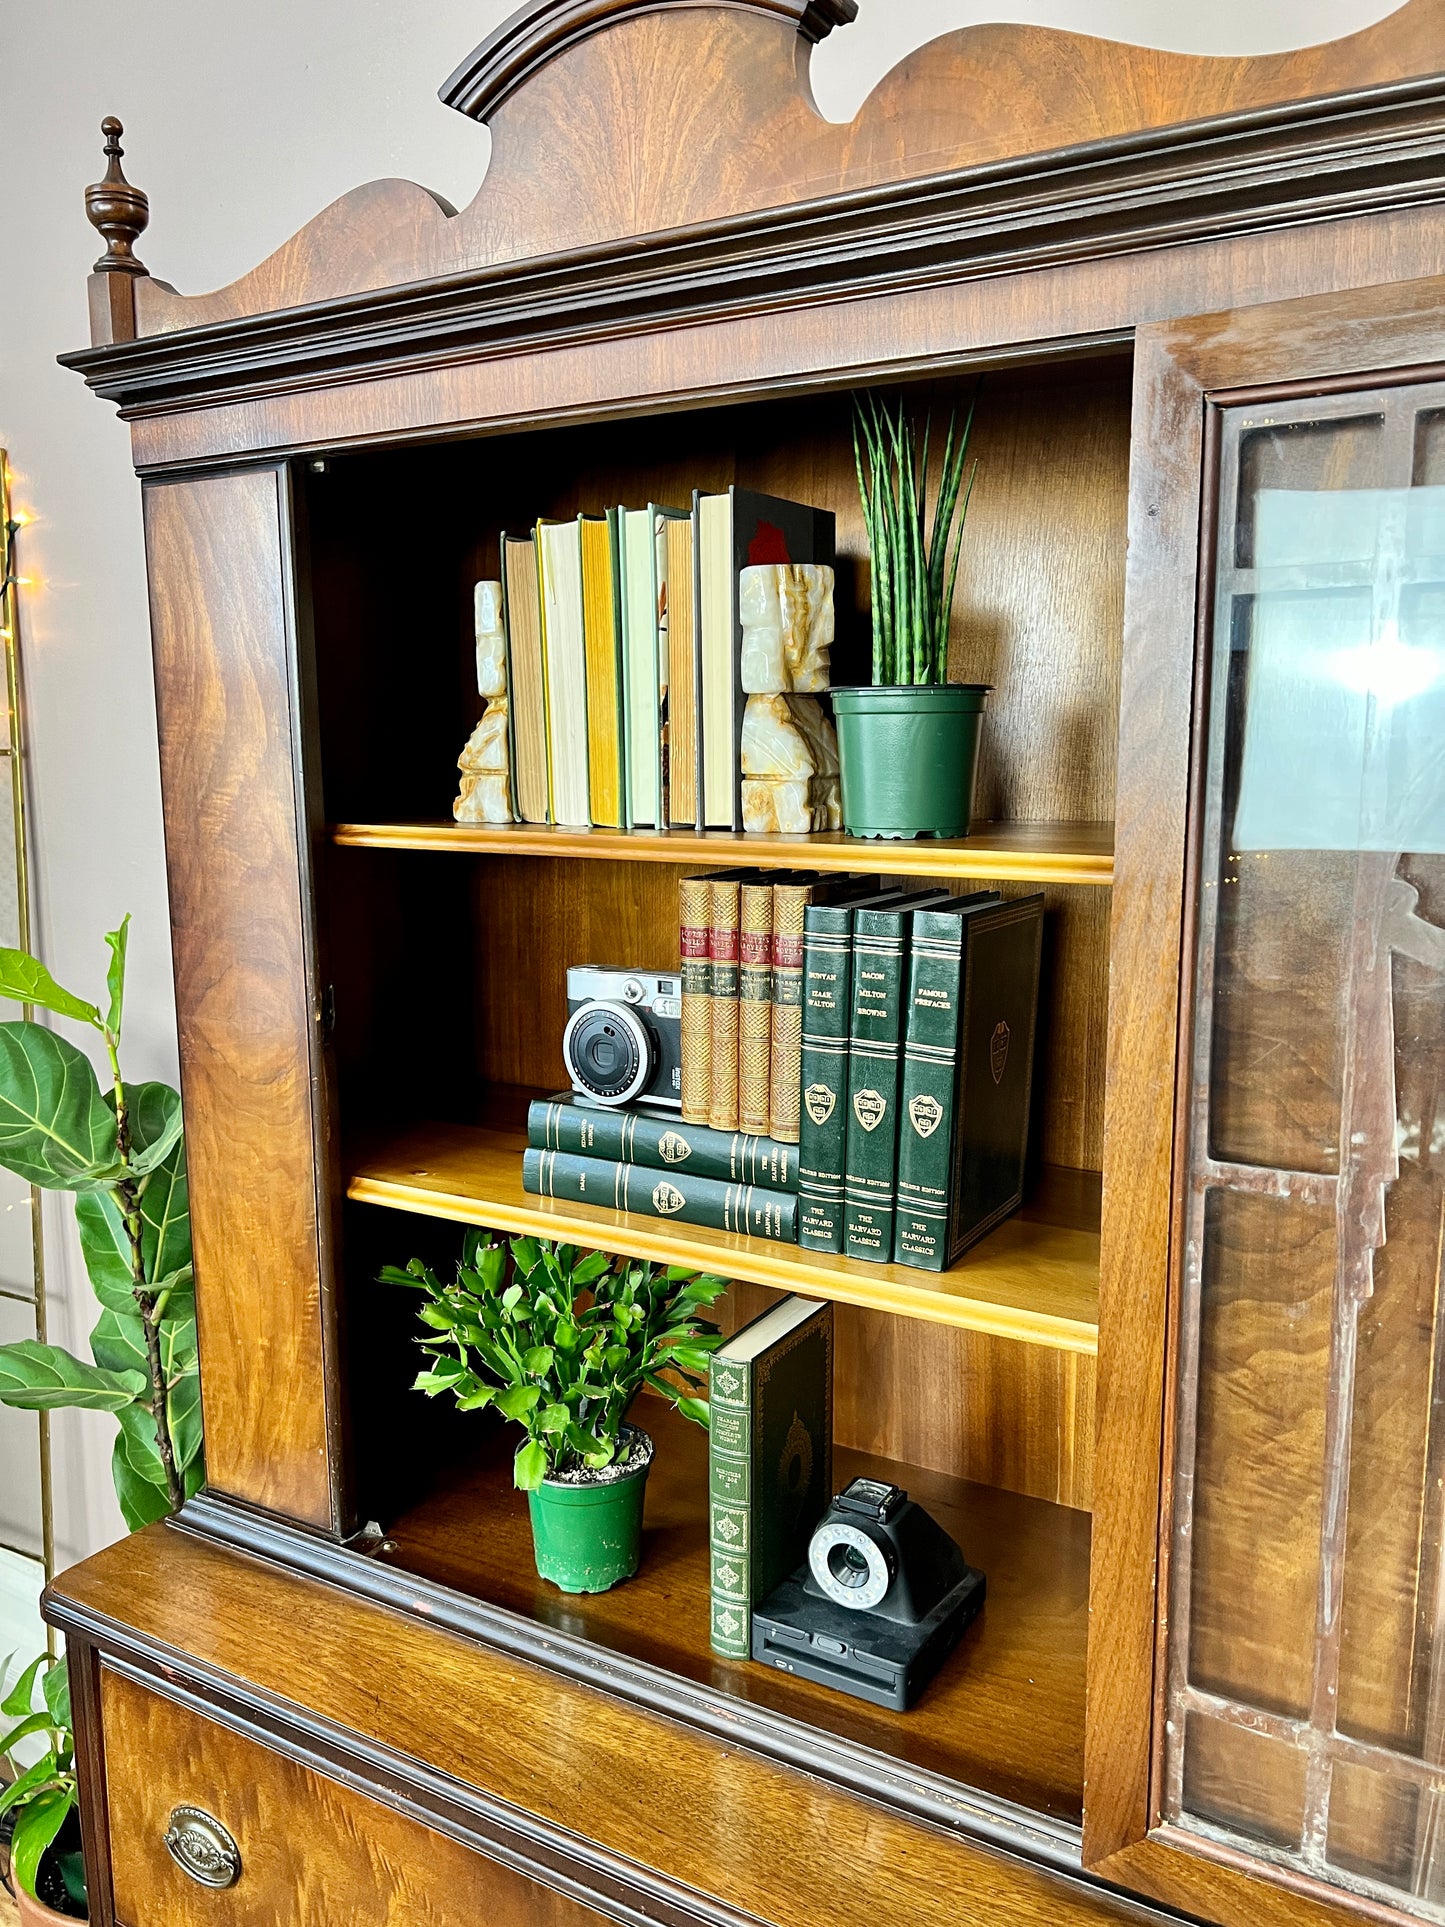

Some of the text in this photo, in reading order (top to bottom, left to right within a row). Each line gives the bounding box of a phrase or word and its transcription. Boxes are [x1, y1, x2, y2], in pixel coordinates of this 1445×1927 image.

[808, 971, 837, 981] BUNYAN
[861, 971, 886, 980] BACON
[812, 990, 832, 999] IZAAK
[859, 989, 887, 999] MILTON
[918, 988, 948, 999] FAMOUS
[808, 999, 836, 1008] WALTON
[914, 998, 951, 1009] PREFACES
[857, 1007, 888, 1018] BROWNE
[771, 1147, 779, 1182] HARVARD
[810, 1206, 825, 1216] THE
[802, 1215, 834, 1228] HARVARD
[858, 1214, 873, 1224] THE
[802, 1226, 833, 1239] CLASSICS
[848, 1223, 882, 1237] HARVARD
[911, 1222, 927, 1232] THE
[849, 1234, 881, 1248] CLASSICS
[901, 1231, 936, 1244] HARVARD
[901, 1242, 935, 1256] CLASSICS
